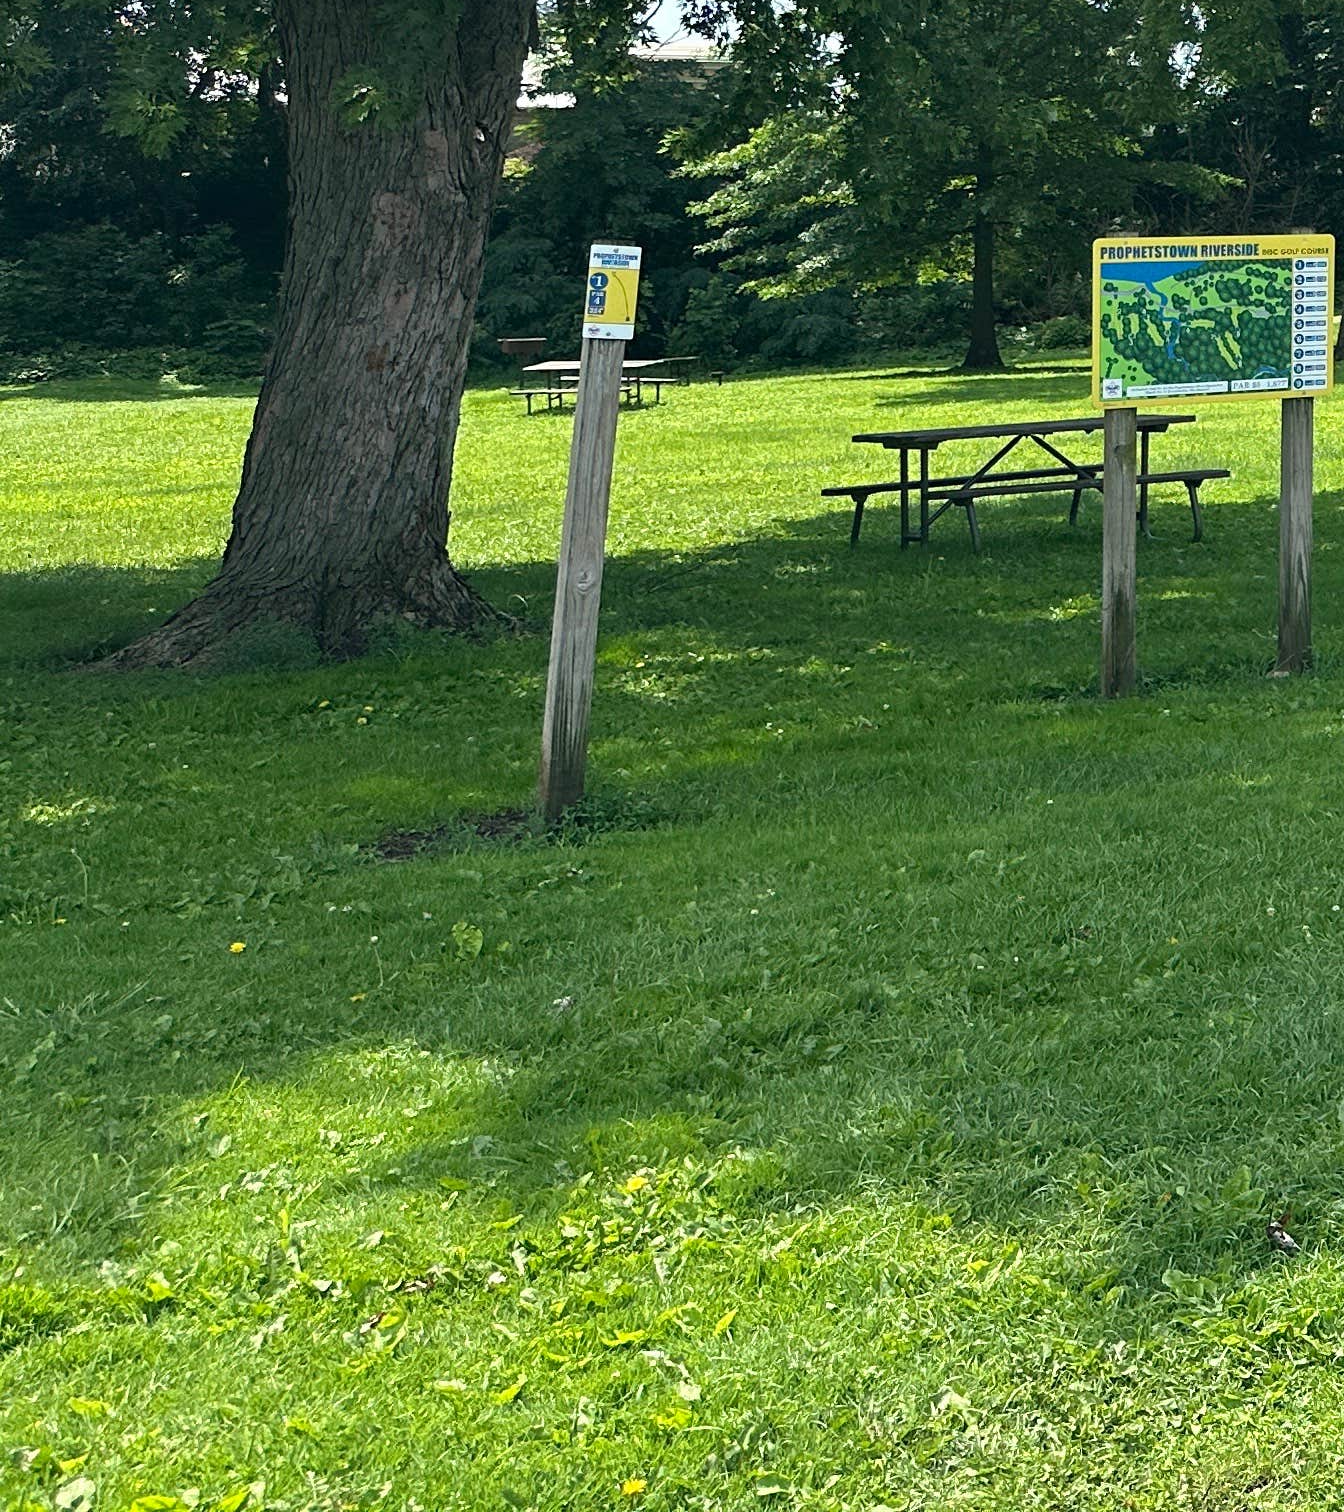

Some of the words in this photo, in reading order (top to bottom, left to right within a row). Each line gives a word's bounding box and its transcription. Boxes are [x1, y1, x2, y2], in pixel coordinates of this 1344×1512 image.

[1100, 245, 1198, 260] PROPHETSTOWN
[1201, 243, 1260, 258] RIVERSIDE
[1280, 247, 1299, 255] GOLF
